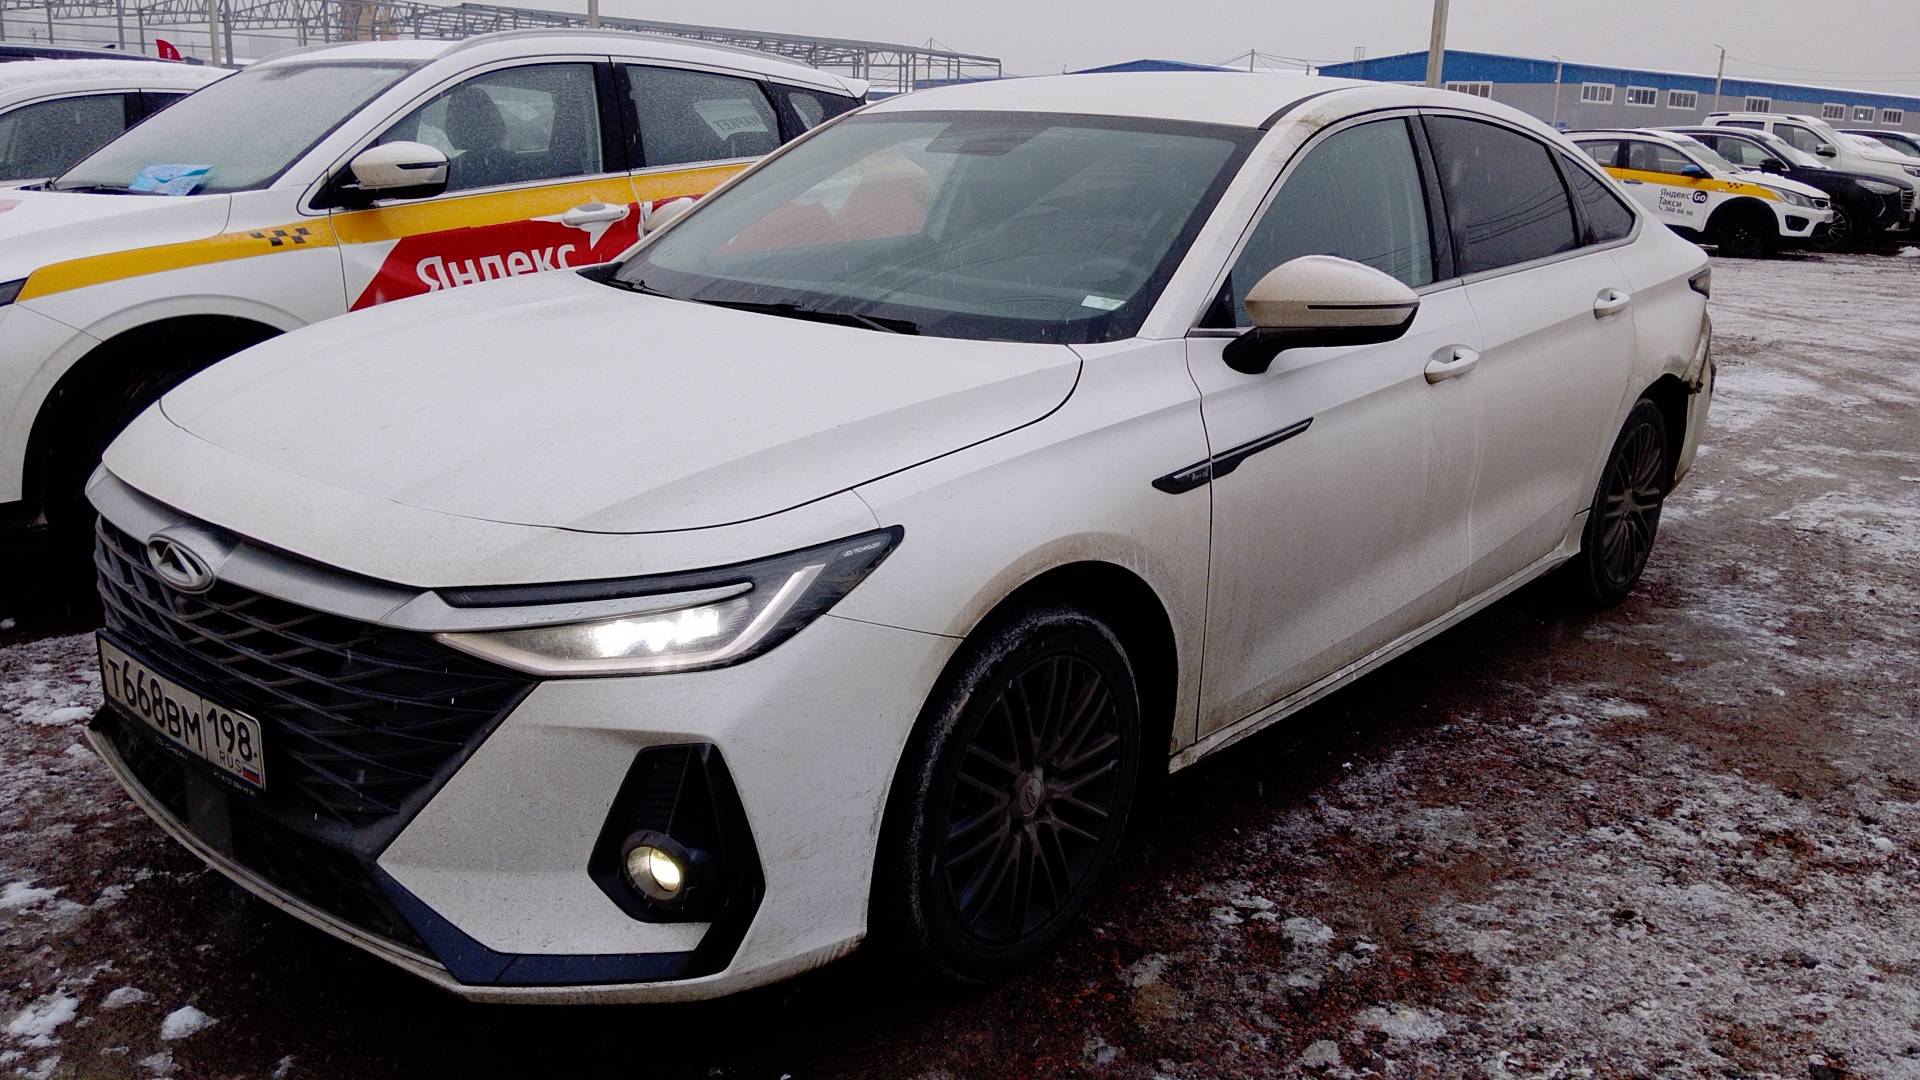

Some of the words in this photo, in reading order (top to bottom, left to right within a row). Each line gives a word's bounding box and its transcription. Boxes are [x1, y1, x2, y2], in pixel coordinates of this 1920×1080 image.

[1660, 188, 1691, 200] Яндекс
[1694, 191, 1706, 202] Go
[1660, 197, 1682, 208] Такси
[207, 707, 253, 762] 198
[219, 751, 242, 773] RUS
